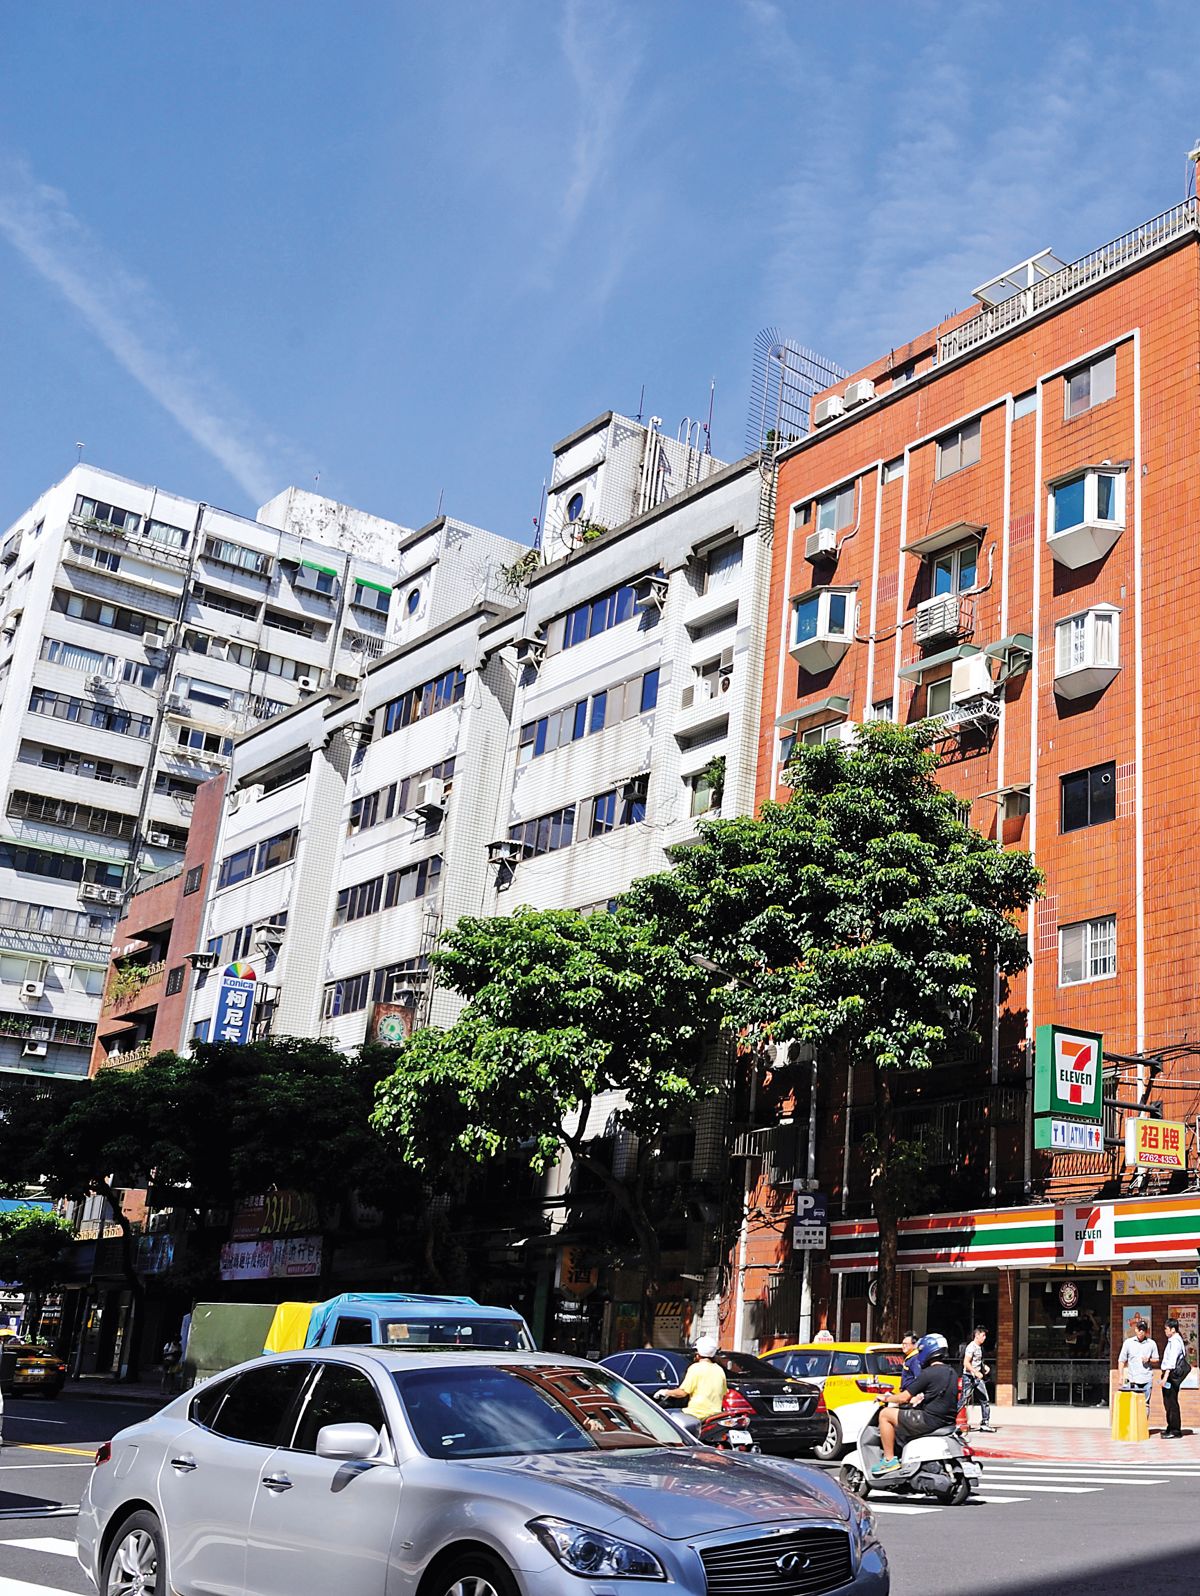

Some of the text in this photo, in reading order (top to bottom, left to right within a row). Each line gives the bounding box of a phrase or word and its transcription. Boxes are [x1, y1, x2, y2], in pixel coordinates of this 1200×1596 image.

[223, 978, 254, 989] Konica
[220, 989, 248, 1042] 柯尼卡
[1070, 1126, 1084, 1147] ATM
[1141, 1124, 1180, 1151] 招牌
[1140, 1152, 1178, 1165] 2762-4353
[796, 1195, 815, 1216] P
